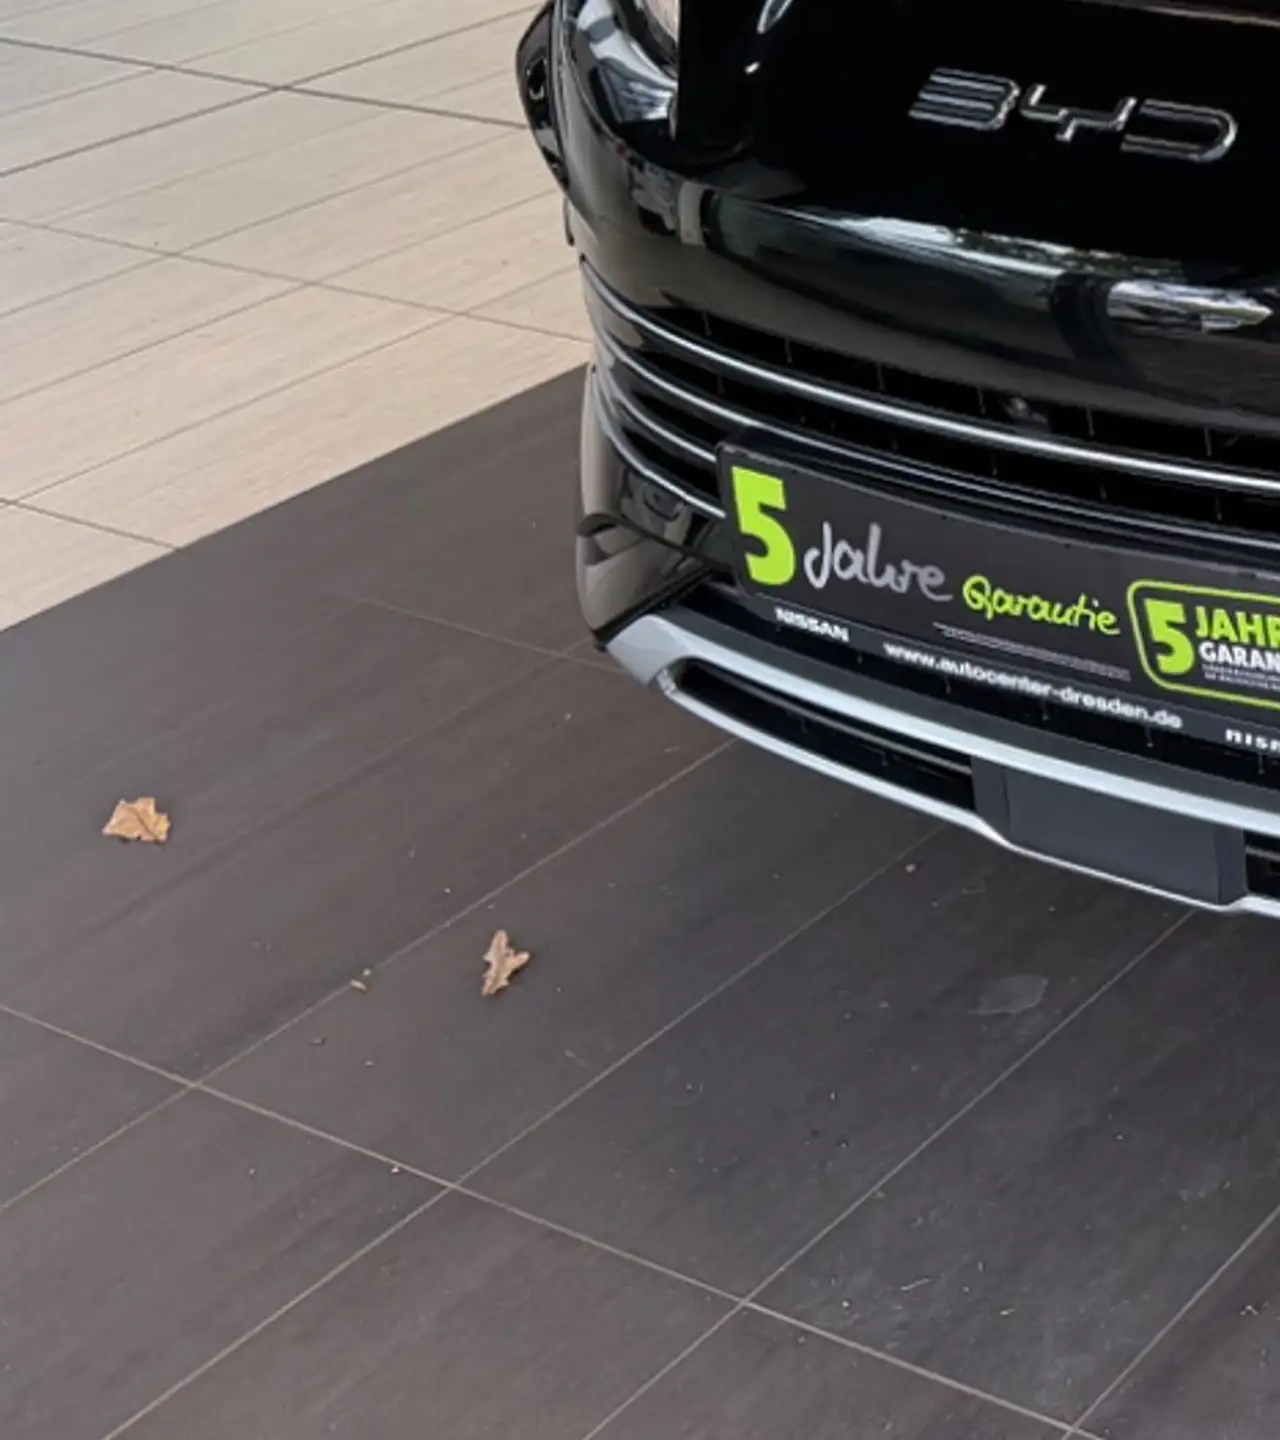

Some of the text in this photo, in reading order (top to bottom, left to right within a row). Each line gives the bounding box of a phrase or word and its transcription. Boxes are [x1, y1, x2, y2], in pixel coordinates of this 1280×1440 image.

[908, 66, 1239, 163] BYD
[731, 465, 1121, 636] 5 Jahre Garantie
[774, 606, 850, 643] NISSAN
[1143, 597, 1196, 676] 5
[882, 641, 1184, 729] www.autocenter-dresden.de
